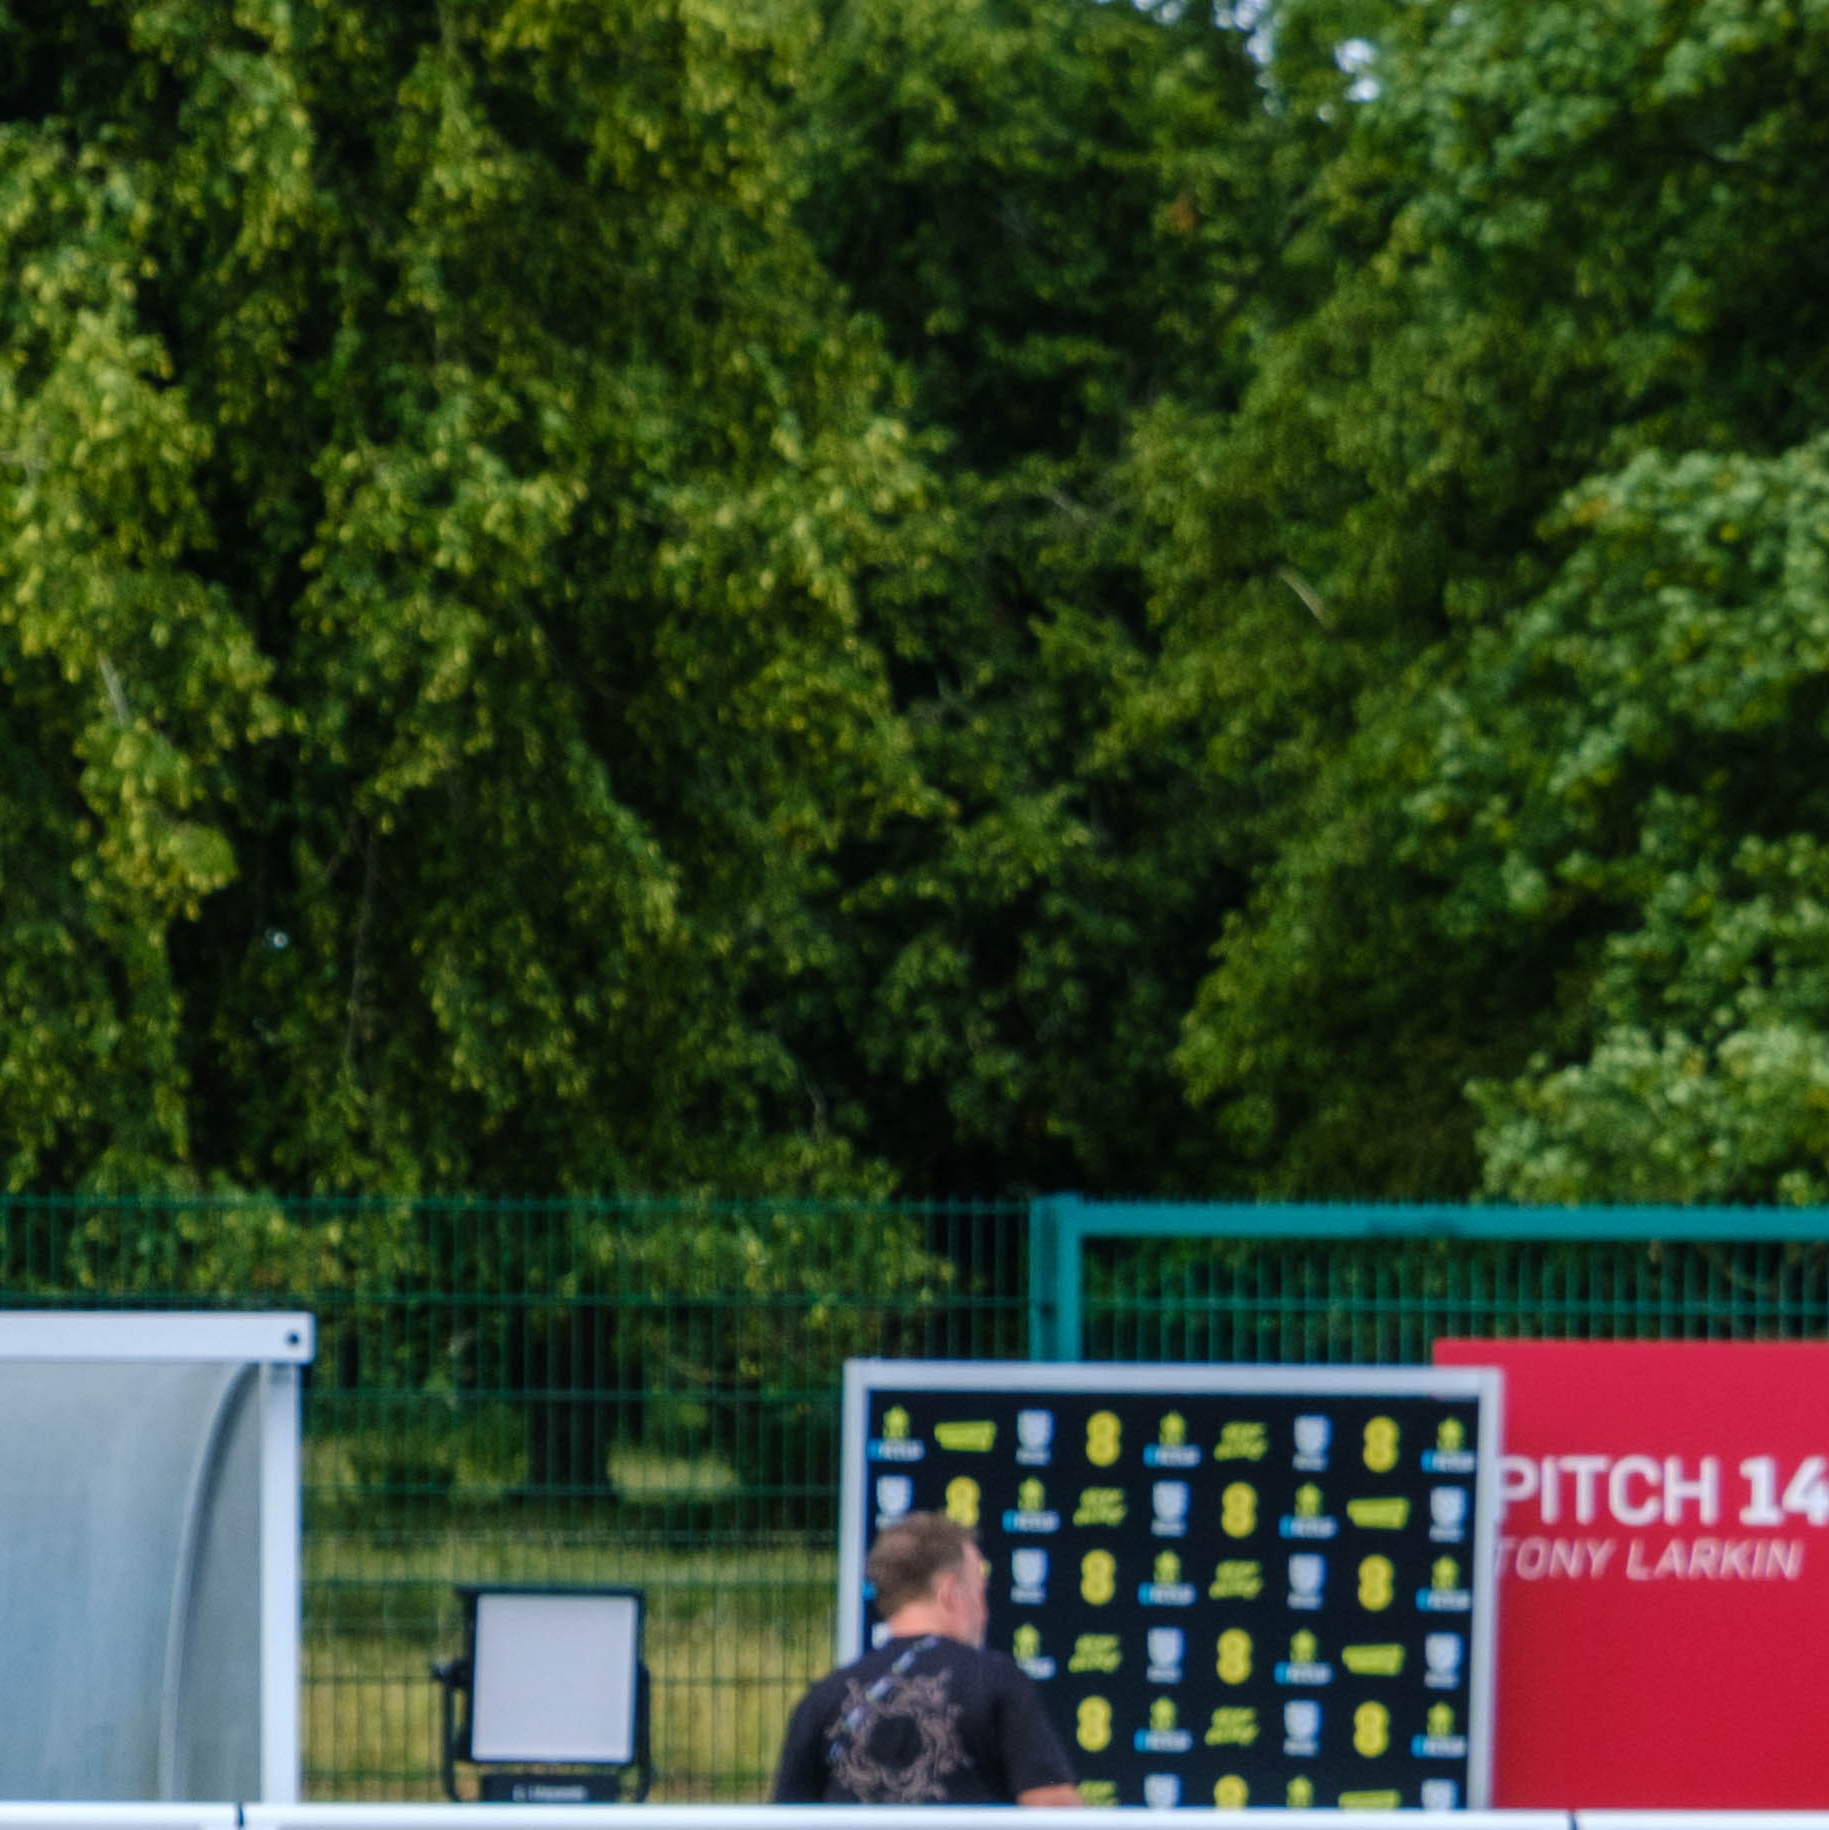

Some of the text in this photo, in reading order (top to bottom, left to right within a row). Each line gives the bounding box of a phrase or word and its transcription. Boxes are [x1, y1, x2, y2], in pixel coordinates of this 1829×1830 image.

[1495, 1454, 1719, 1526] PITCH
[1739, 1454, 1829, 1526] 14
[1497, 1536, 1805, 1581] TONY LARKIN
